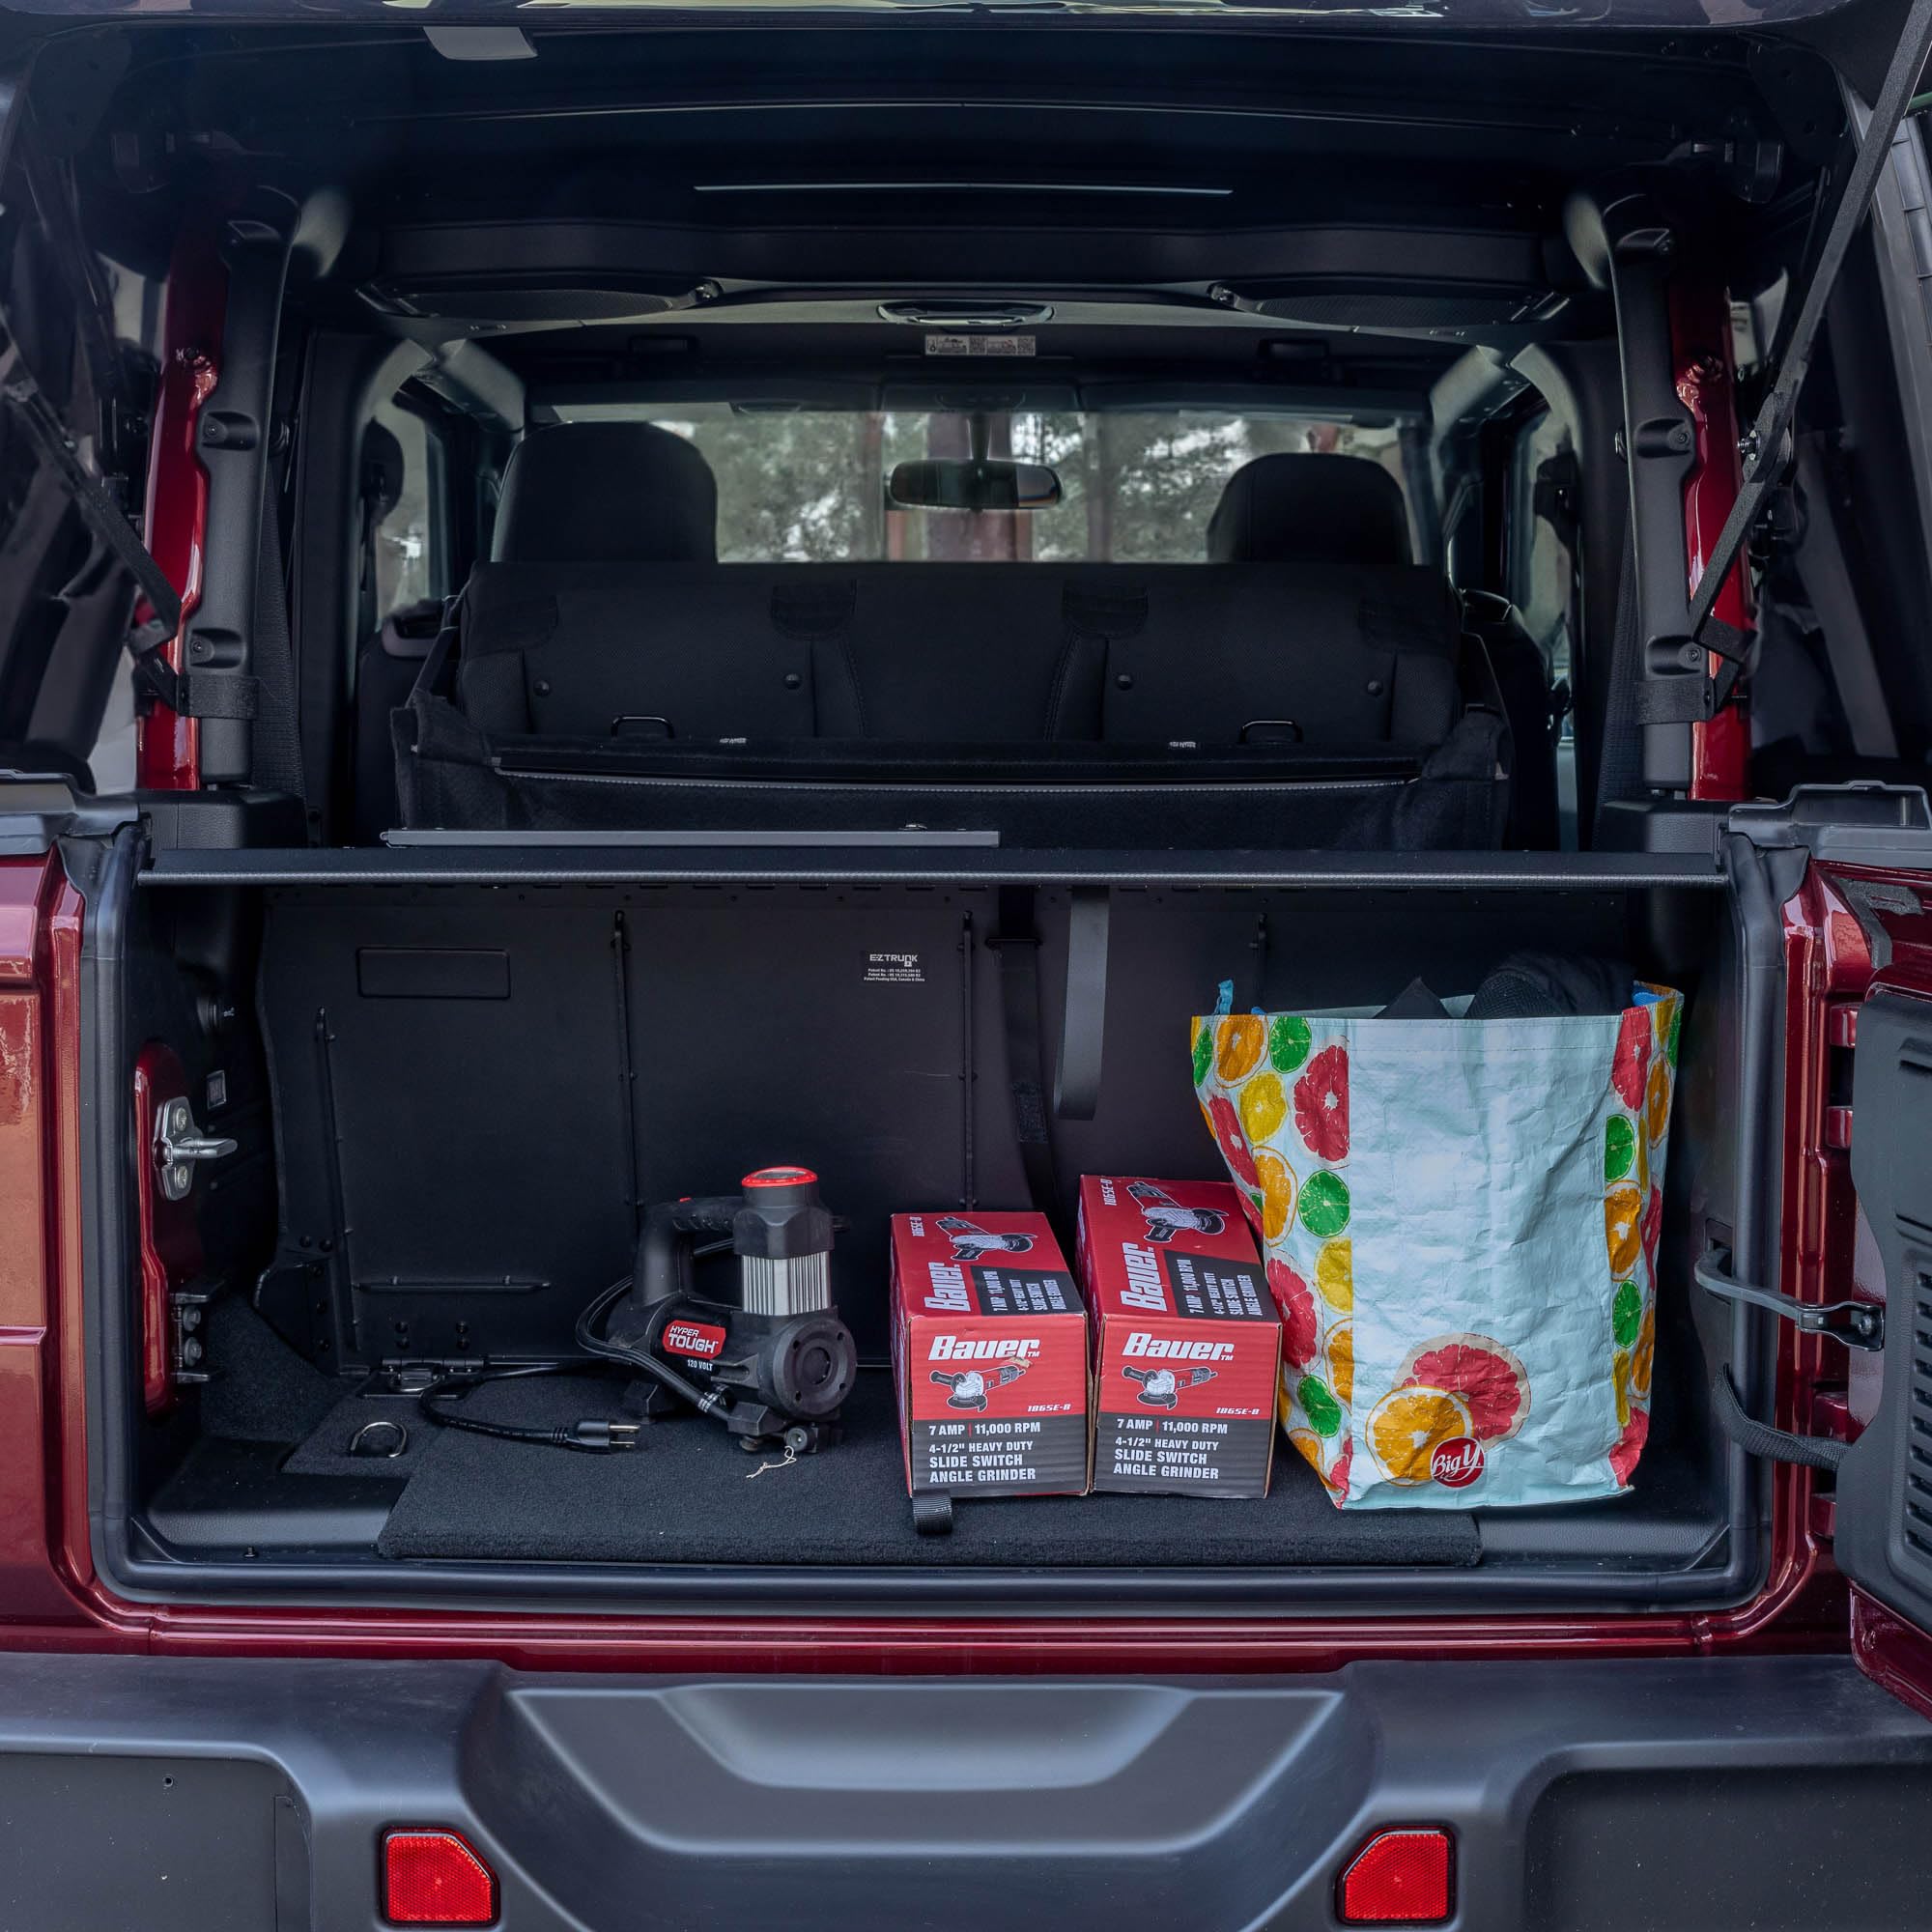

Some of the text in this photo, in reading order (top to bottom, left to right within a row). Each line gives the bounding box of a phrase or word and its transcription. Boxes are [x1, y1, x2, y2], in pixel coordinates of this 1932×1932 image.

[1177, 1259, 1194, 1272] RPM
[1121, 1242, 1167, 1312] Bauer
[924, 1262, 971, 1312] Bauer
[1185, 1294, 1204, 1309] AMP
[1226, 1299, 1244, 1315] SLIDE
[669, 1324, 699, 1337] HYPER
[668, 1333, 716, 1353] TOUGH
[928, 1335, 1040, 1361] Bauer
[1122, 1332, 1235, 1360] Bauer
[687, 1359, 713, 1372] 120 VOLT
[929, 1422, 1041, 1436] 7 AMP 11,000 RPM
[1117, 1418, 1228, 1434] 7 AMP 11,000 RPM
[968, 1442, 1003, 1453] HEAVY
[1006, 1440, 1034, 1451] DUTY
[1154, 1438, 1189, 1449] HEAVY
[1192, 1440, 1219, 1451] DUTY
[929, 1454, 1023, 1468] SLIDE SWITCH
[1115, 1449, 1208, 1464] SLIDE SWITCH
[1113, 1463, 1219, 1479] ANGLE GRINDER
[1432, 1454, 1462, 1478] Big
[929, 1468, 1036, 1483] ANGLE GRINDER
